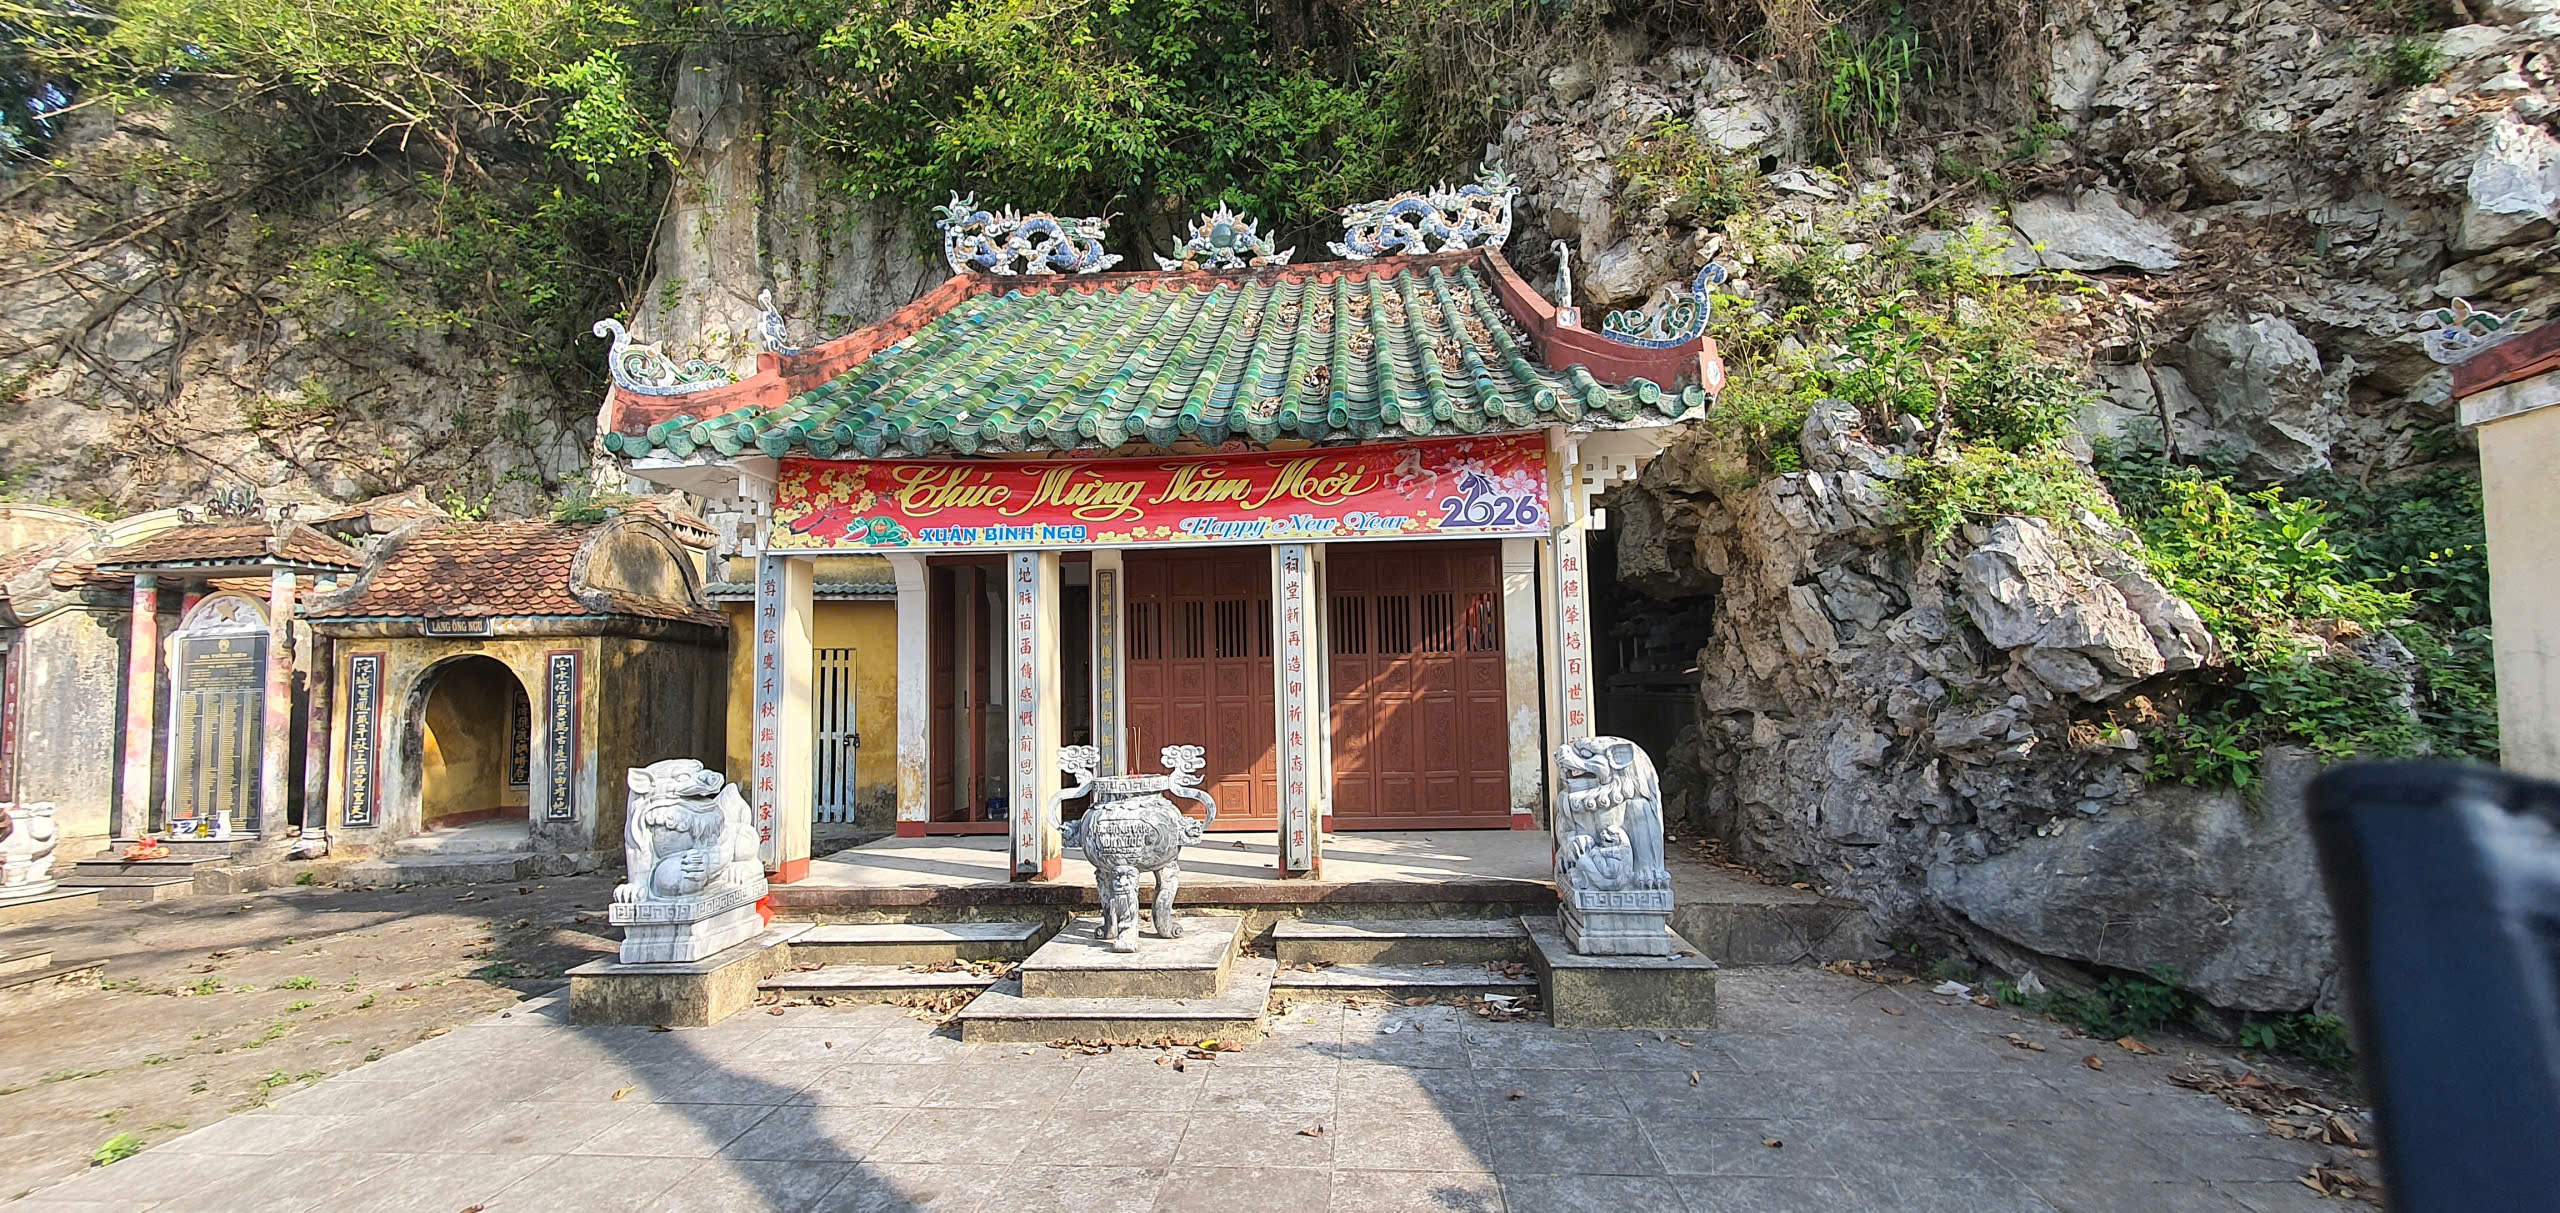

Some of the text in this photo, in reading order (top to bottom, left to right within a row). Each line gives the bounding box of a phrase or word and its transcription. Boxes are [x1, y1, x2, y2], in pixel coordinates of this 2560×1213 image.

[892, 456, 1381, 523] Chúc Mừng Năm Mới
[1438, 482, 1541, 528] 2026
[919, 522, 1088, 544] XUÂN BÍNH NGỌ
[1180, 511, 1410, 538] Happy New Year
